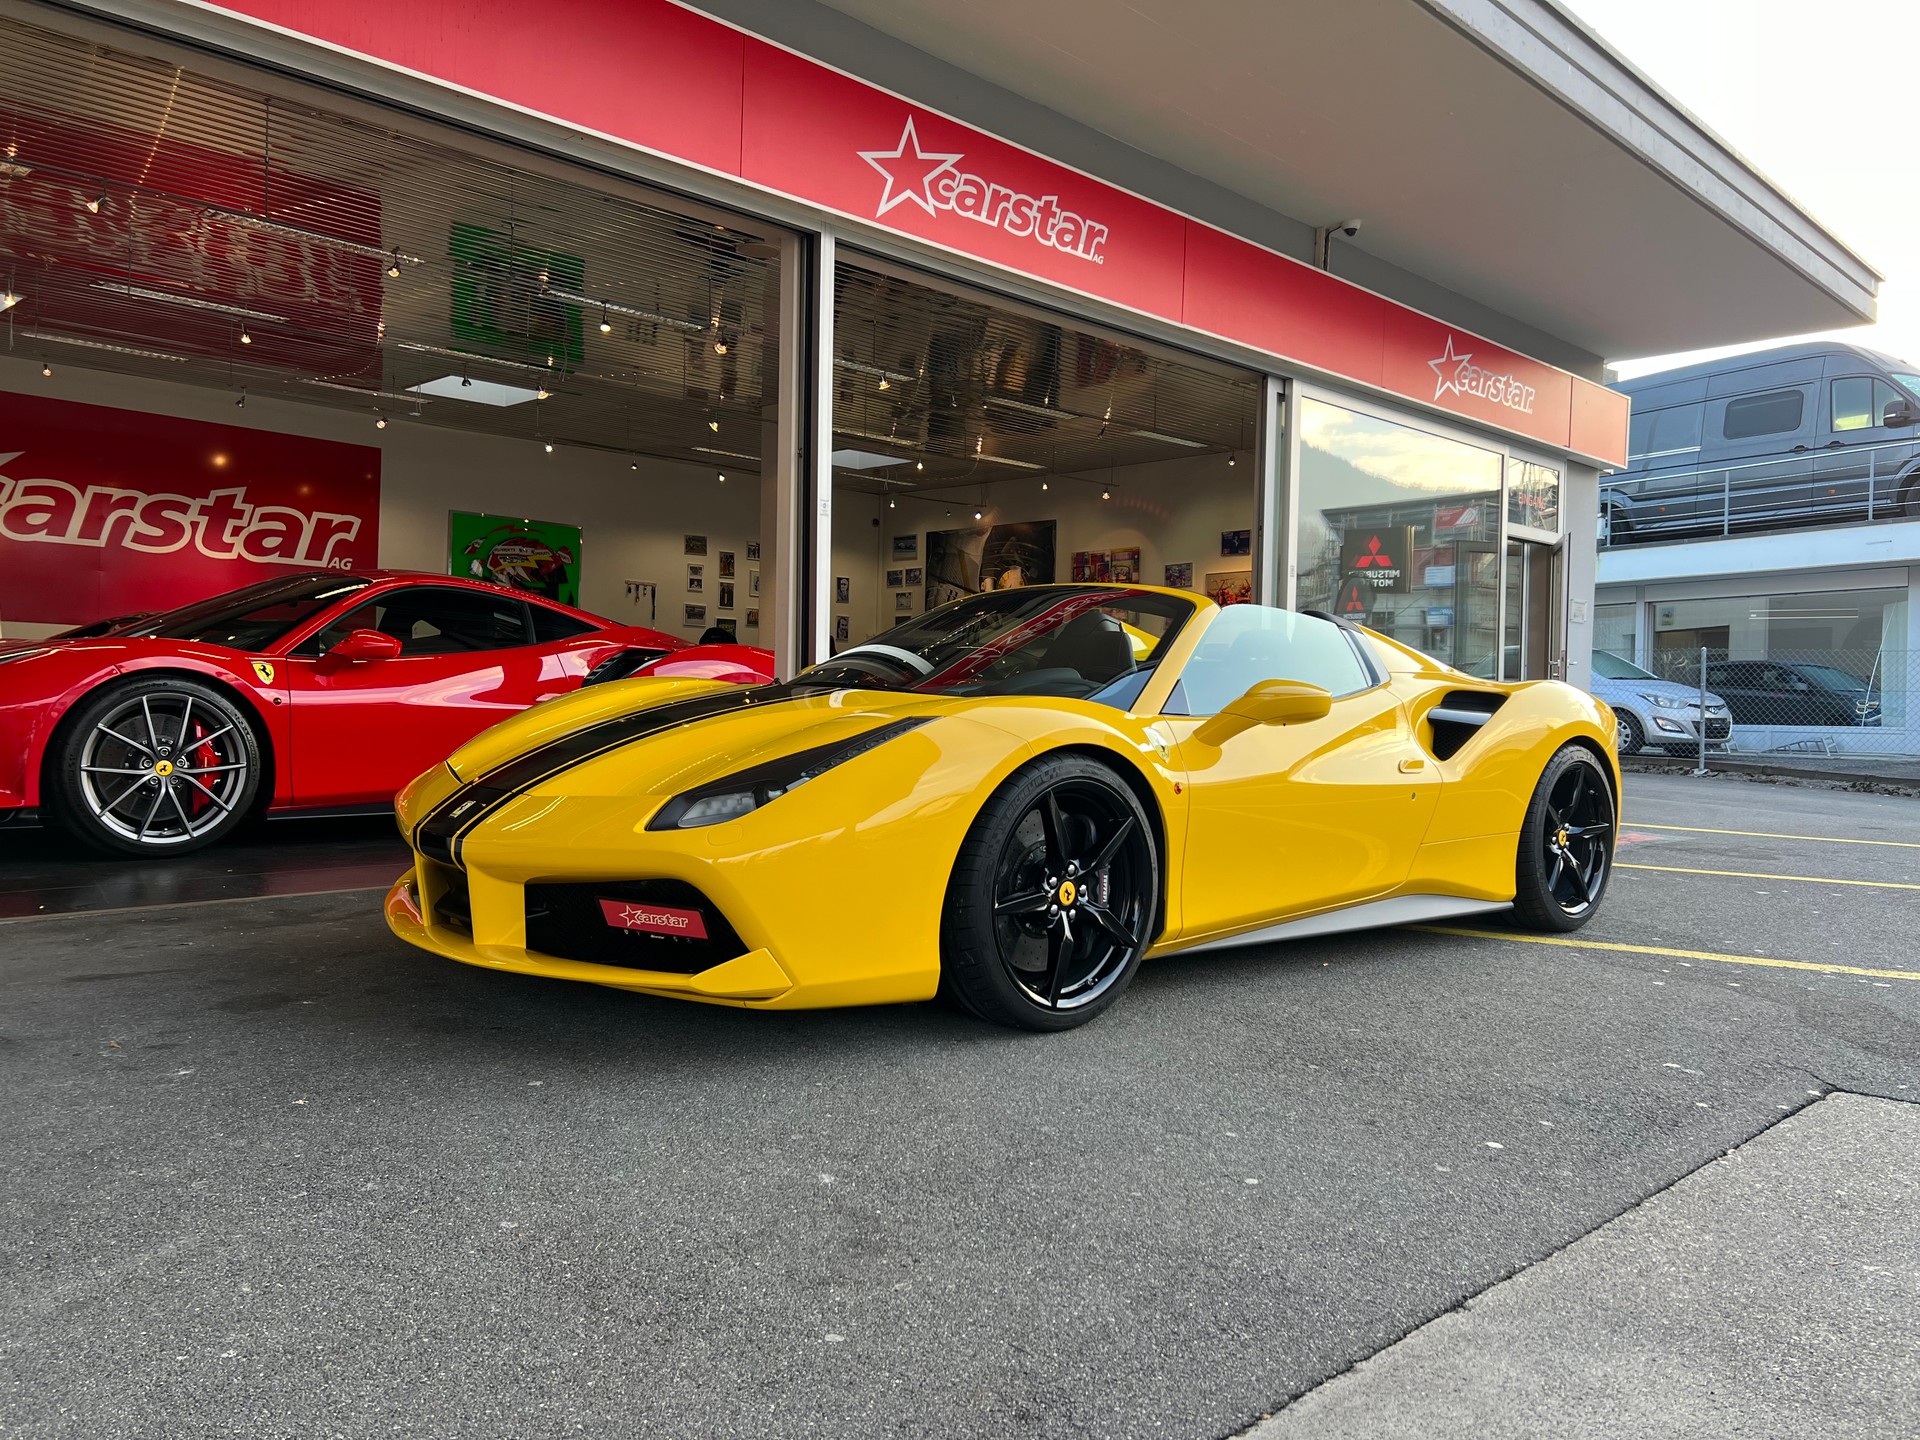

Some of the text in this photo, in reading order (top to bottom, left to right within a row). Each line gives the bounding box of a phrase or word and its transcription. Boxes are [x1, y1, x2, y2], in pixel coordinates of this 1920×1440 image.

[923, 167, 1109, 265] carstar AG
[1455, 362, 1536, 412] carstar
[328, 556, 353, 571] AG
[635, 912, 688, 928] carstar
